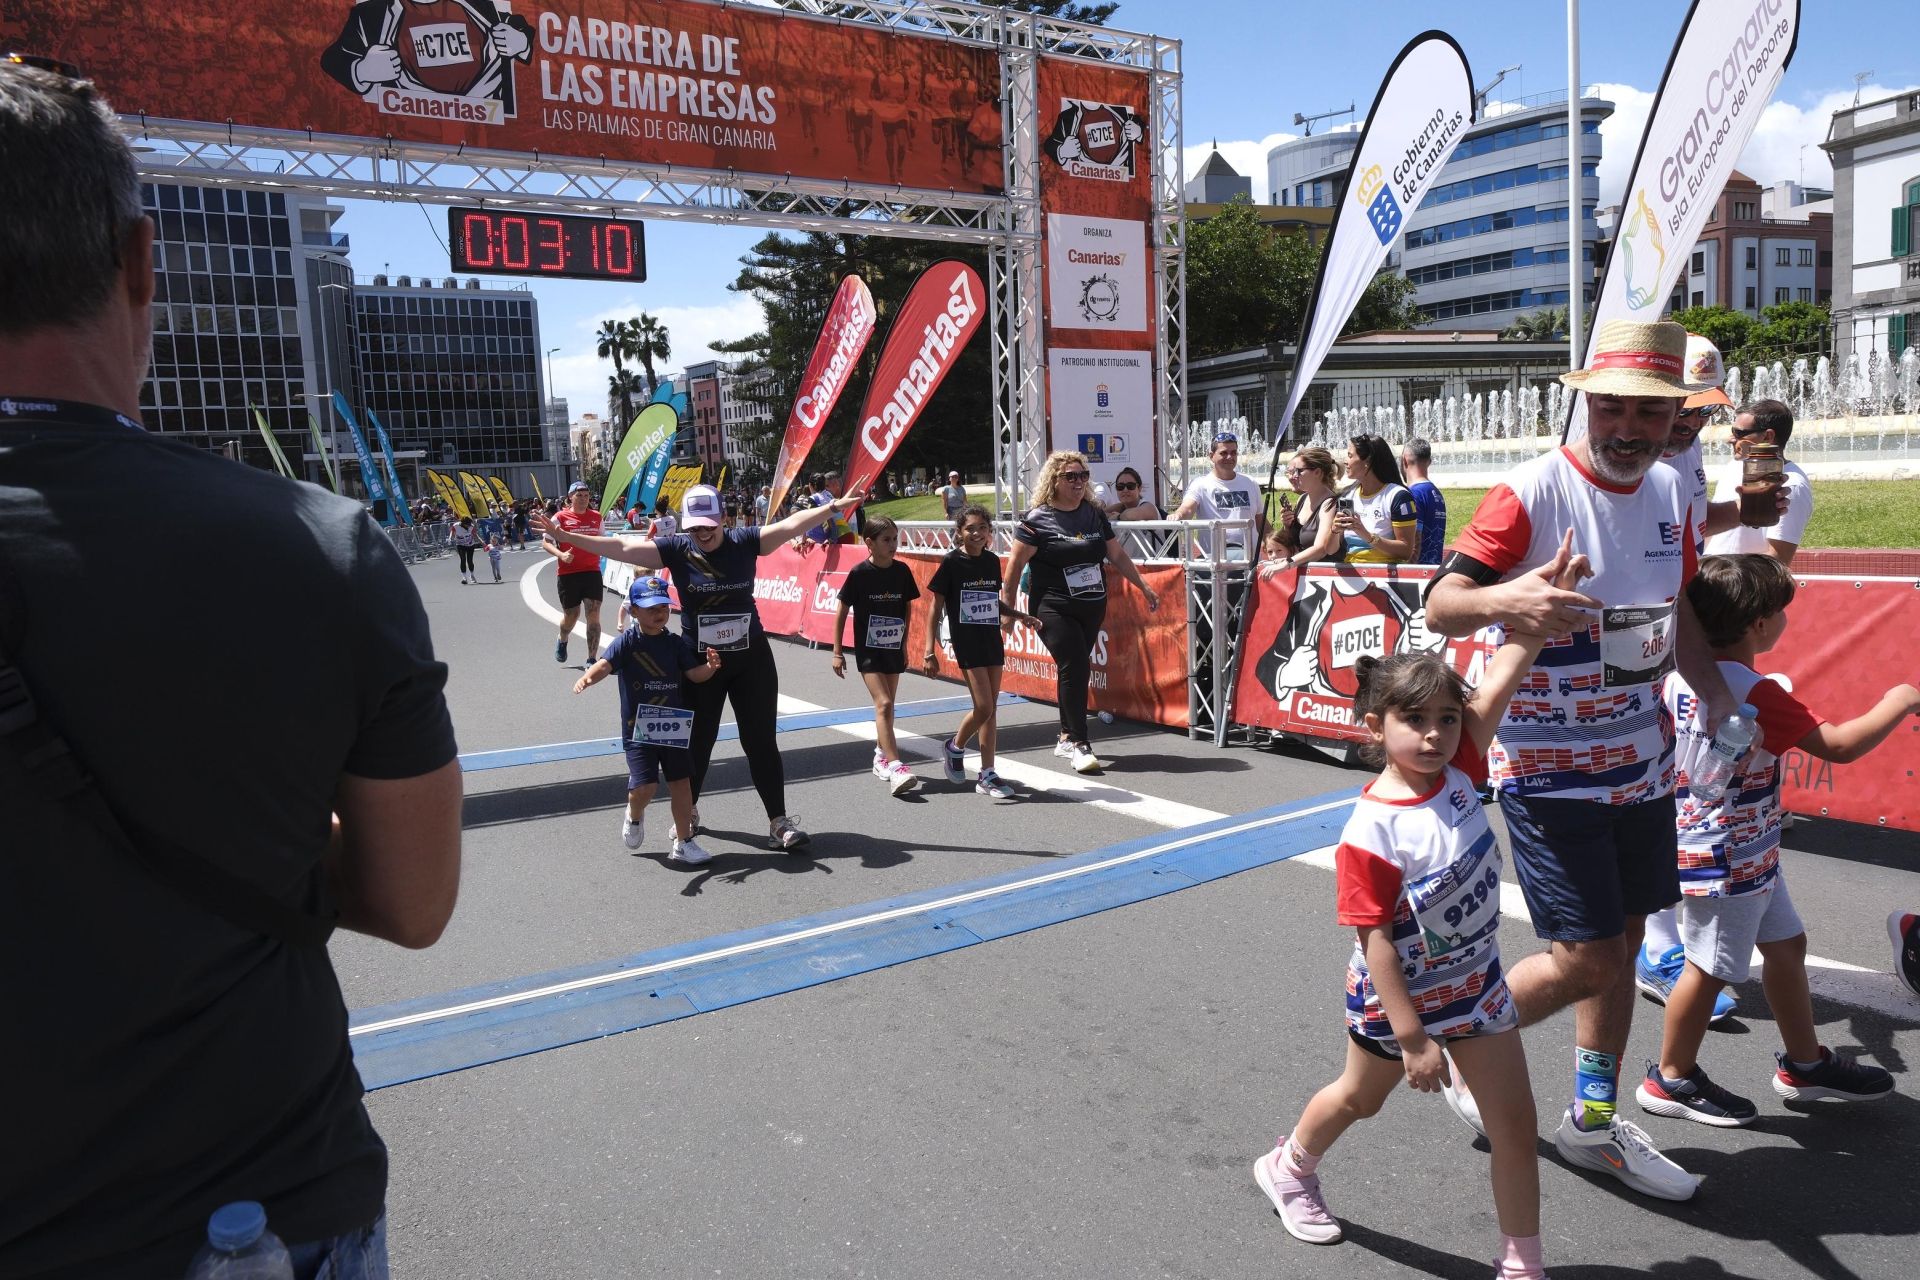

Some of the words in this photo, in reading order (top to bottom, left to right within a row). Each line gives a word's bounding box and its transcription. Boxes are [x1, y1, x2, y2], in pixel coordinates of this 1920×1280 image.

[415, 31, 470, 59] #C7CE
[539, 11, 700, 71] CARRERA
[702, 34, 741, 76] DE
[382, 89, 499, 122] Canarias7
[540, 60, 602, 102] LAS
[611, 67, 777, 124] EMPRESAS
[543, 108, 573, 130] LAS
[578, 112, 640, 137] PALMAS
[645, 118, 664, 140] DE
[667, 120, 708, 143] GRAN
[712, 124, 777, 150] CANARIA
[1088, 126, 1114, 143] #C7CE
[1668, 202, 1689, 237] Isla
[1687, 117, 1730, 196] Europea
[1731, 90, 1749, 118] del
[1747, 18, 1789, 88] Deporte
[1393, 108, 1444, 185] Gobierno
[1402, 179, 1418, 204] de
[1415, 110, 1463, 181] Canarias
[1659, 107, 1710, 204] Gran
[1071, 162, 1127, 180] Canarias7
[1083, 227, 1112, 238] ORGANIZA
[1068, 249, 1127, 266] Canarias7
[796, 288, 867, 429] Canarias7
[861, 270, 977, 462] Canarias7
[1061, 357, 1096, 368] PATROCINIO
[1097, 358, 1140, 369] INSTITUCIONAL
[627, 424, 666, 471] Binter
[716, 628, 734, 639] 3931
[876, 629, 898, 638] 9202
[1335, 625, 1381, 656] #C7CE
[1012, 658, 1040, 677] PALMAS
[1040, 663, 1050, 680] DE
[1297, 696, 1353, 725] Canar
[647, 722, 681, 733] 9109
[1415, 869, 1455, 900] HPS
[1444, 866, 1498, 928] 9296
